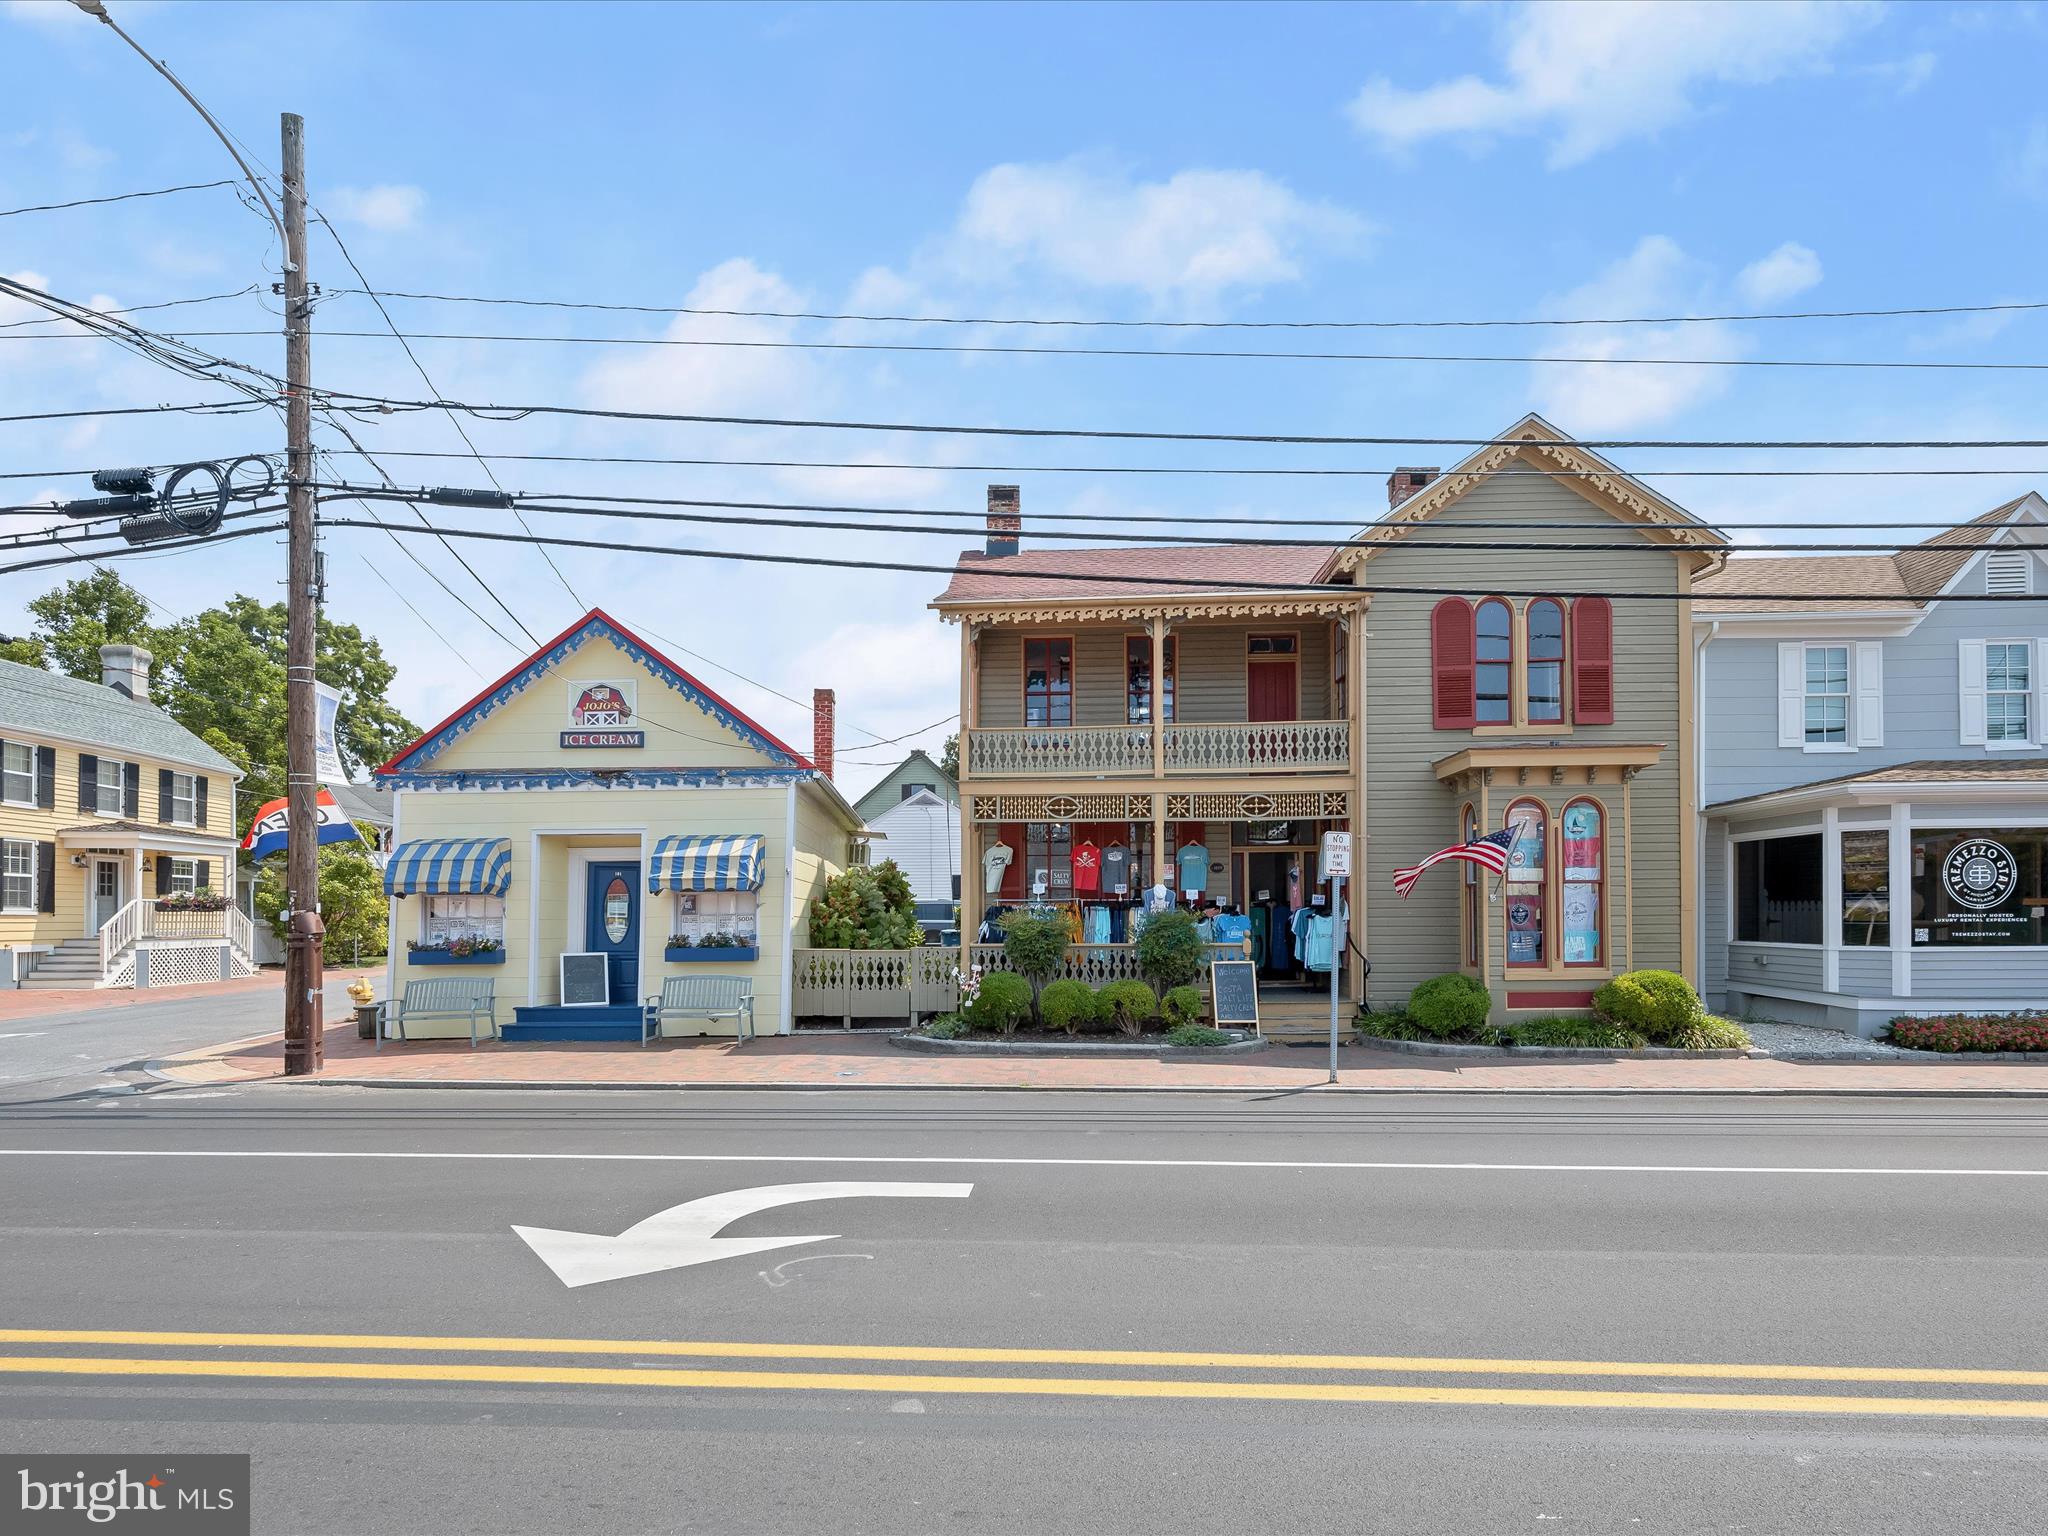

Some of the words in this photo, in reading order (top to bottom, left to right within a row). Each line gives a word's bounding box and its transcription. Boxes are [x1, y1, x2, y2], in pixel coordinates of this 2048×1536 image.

[583, 701, 621, 711] JOJO'S
[563, 735, 587, 745] ICE
[589, 734, 640, 746] CREAM
[1332, 836, 1344, 844] NO
[1326, 844, 1350, 852] STOPPING
[1950, 845, 1998, 891] TREMEZZO
[1996, 860, 2009, 891] STAY
[1964, 895, 1995, 903] MARYLAND
[1216, 965, 1250, 976] Welcome
